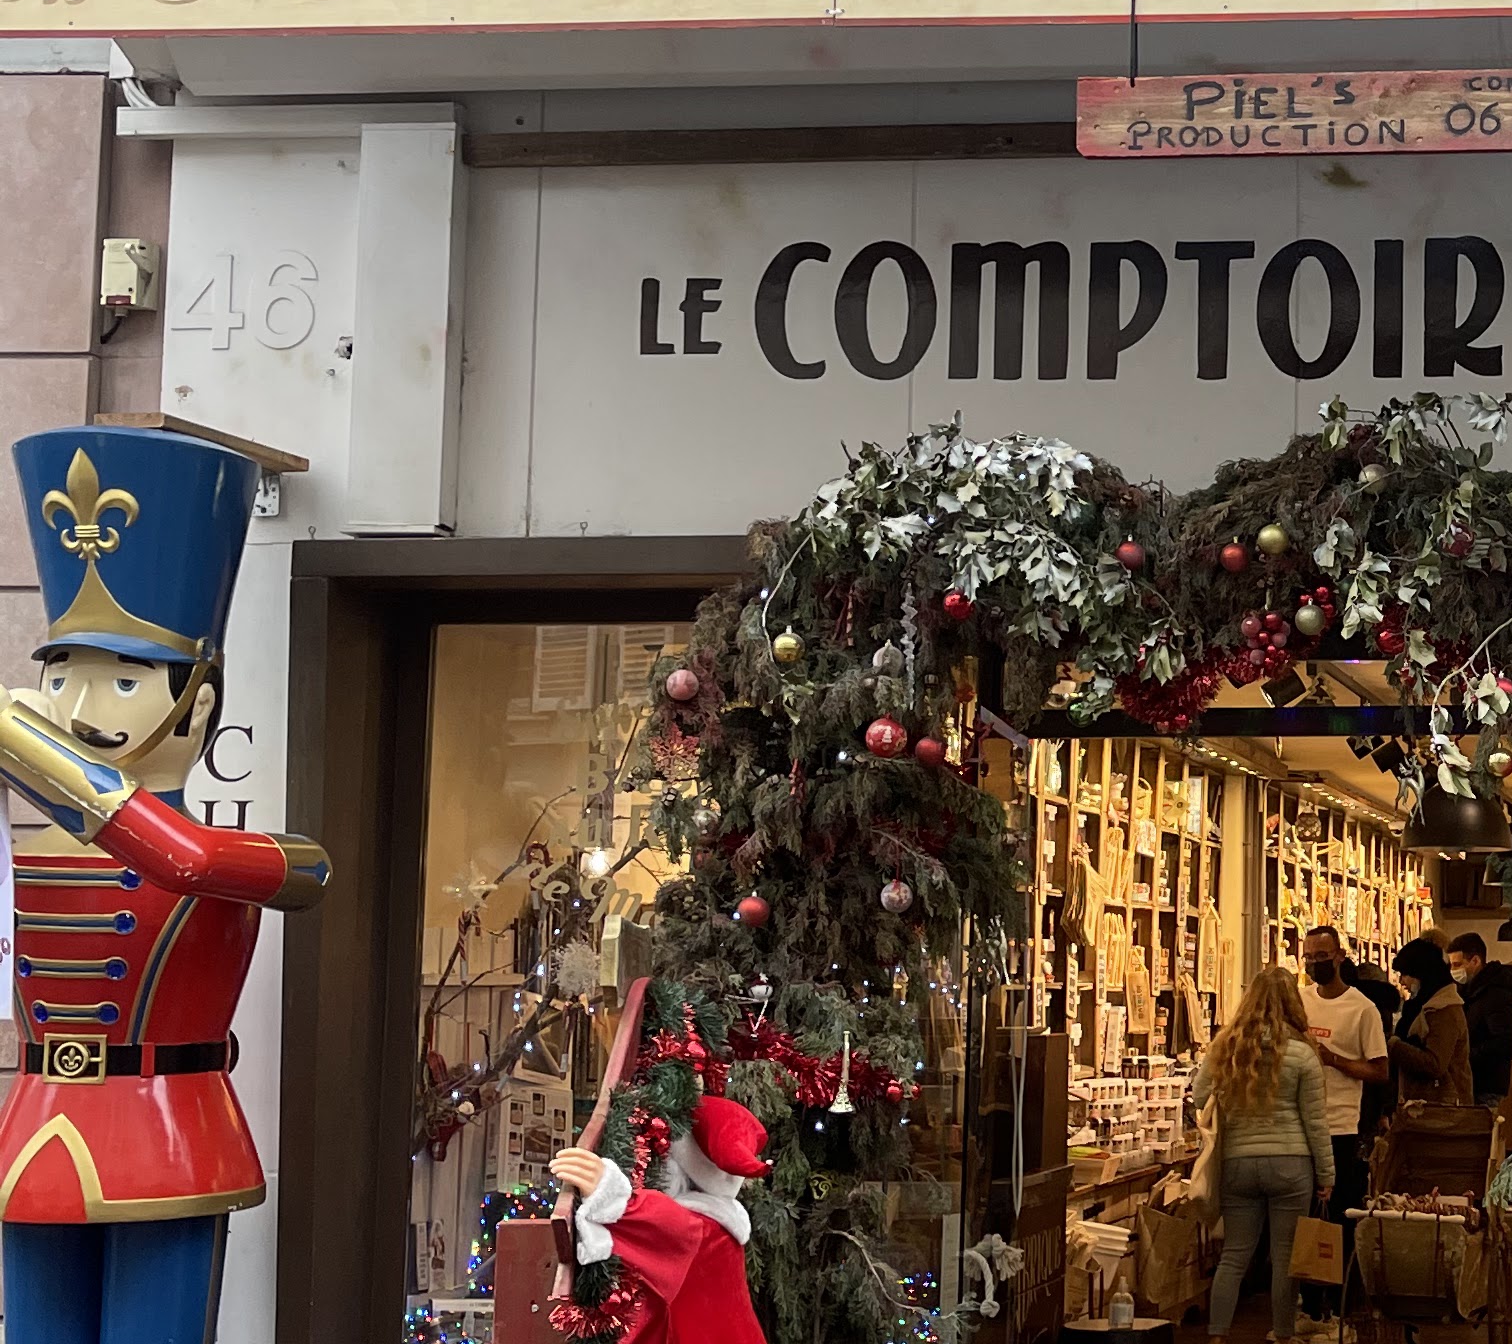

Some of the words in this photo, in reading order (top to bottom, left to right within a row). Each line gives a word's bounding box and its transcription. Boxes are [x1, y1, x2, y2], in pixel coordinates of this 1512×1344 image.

[1445, 102, 1502, 135] 06
[171, 250, 319, 351] 46
[639, 276, 723, 356] LE
[754, 235, 1505, 382] COMPTOIR
